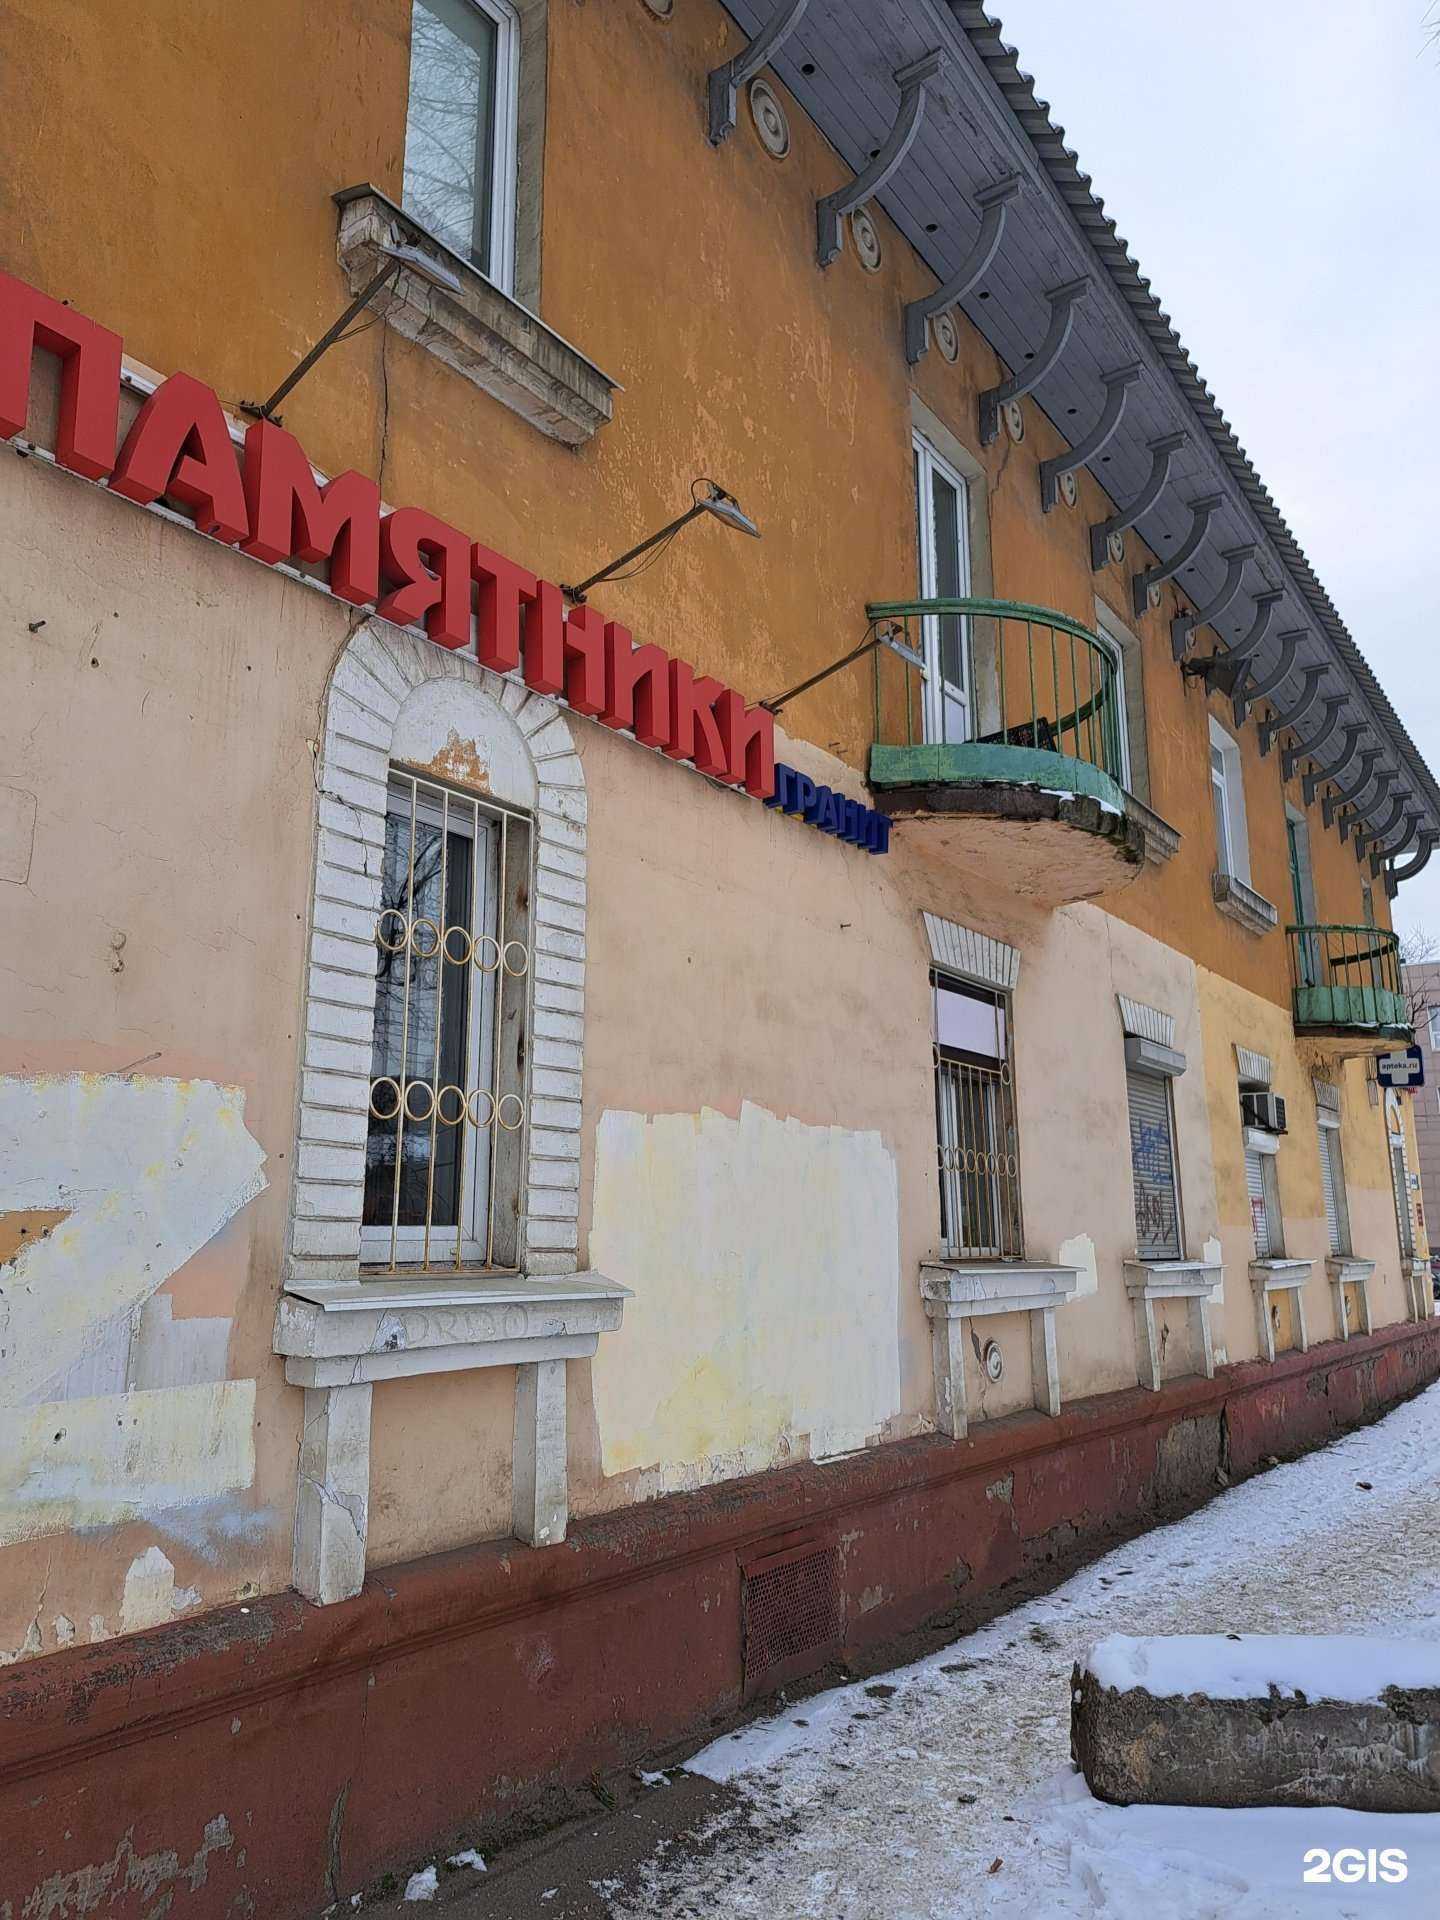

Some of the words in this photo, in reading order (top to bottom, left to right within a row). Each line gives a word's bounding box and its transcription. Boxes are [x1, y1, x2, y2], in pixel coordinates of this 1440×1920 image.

[0, 271, 775, 798] ПАМЯТНИКИ
[762, 762, 893, 855] ГРАНИТ
[1381, 1061, 1418, 1071] apteka.ru
